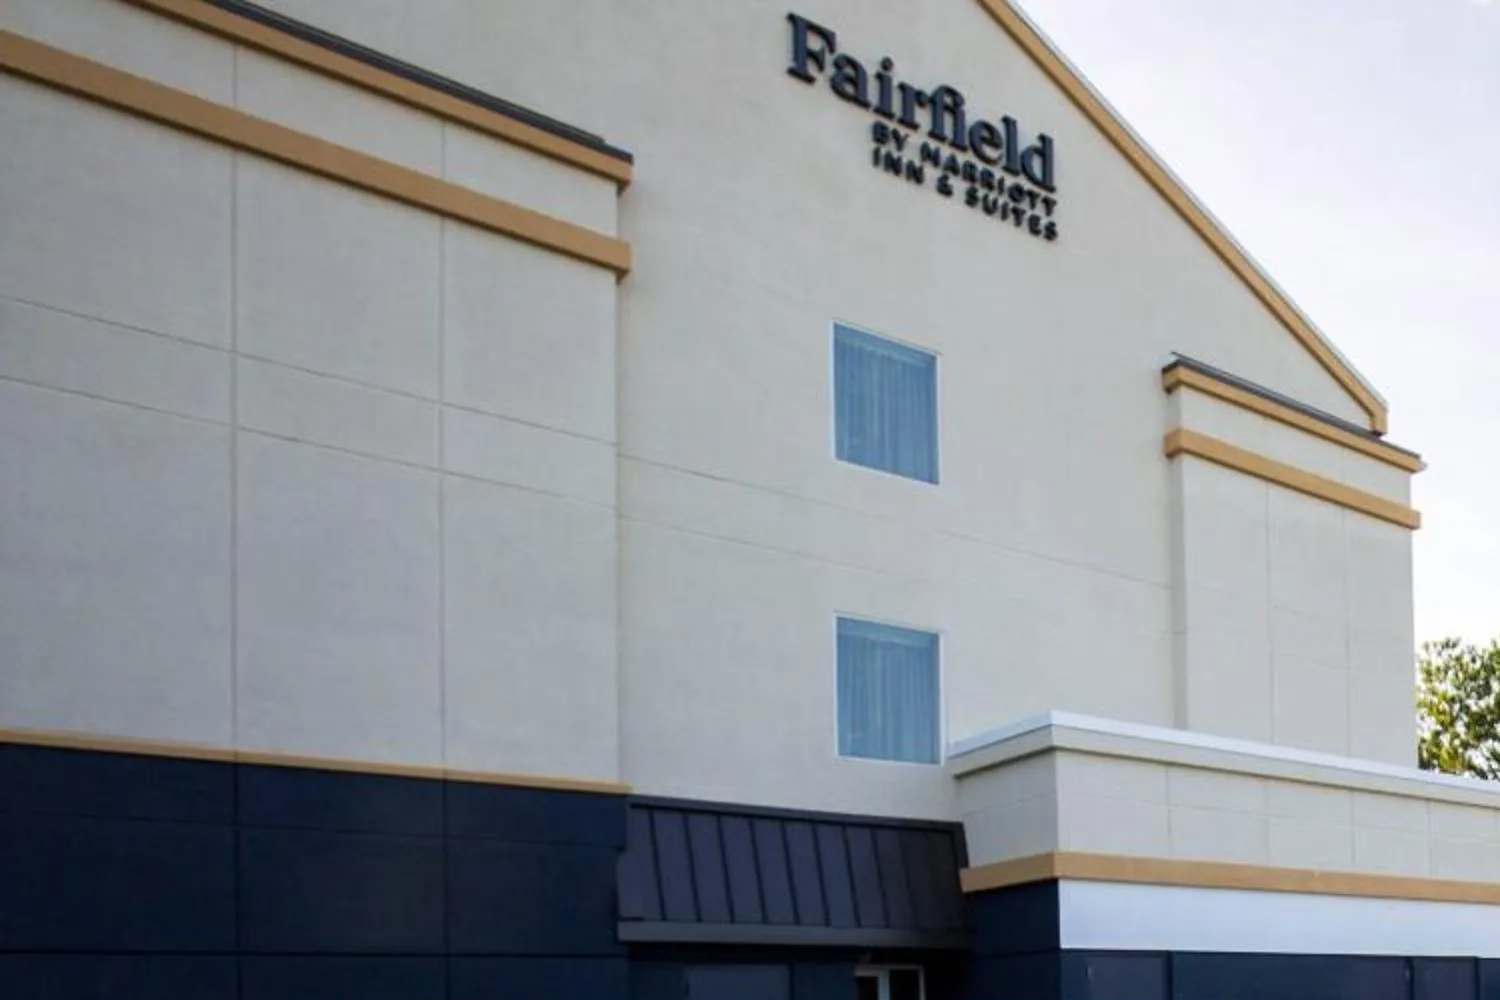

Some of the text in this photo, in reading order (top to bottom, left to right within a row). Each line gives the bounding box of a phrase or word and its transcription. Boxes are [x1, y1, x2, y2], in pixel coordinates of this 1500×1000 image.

[786, 12, 1056, 193] Fairfield
[872, 121, 1057, 216] BY MARRIOTT
[872, 147, 1058, 241] INN & SUITES
